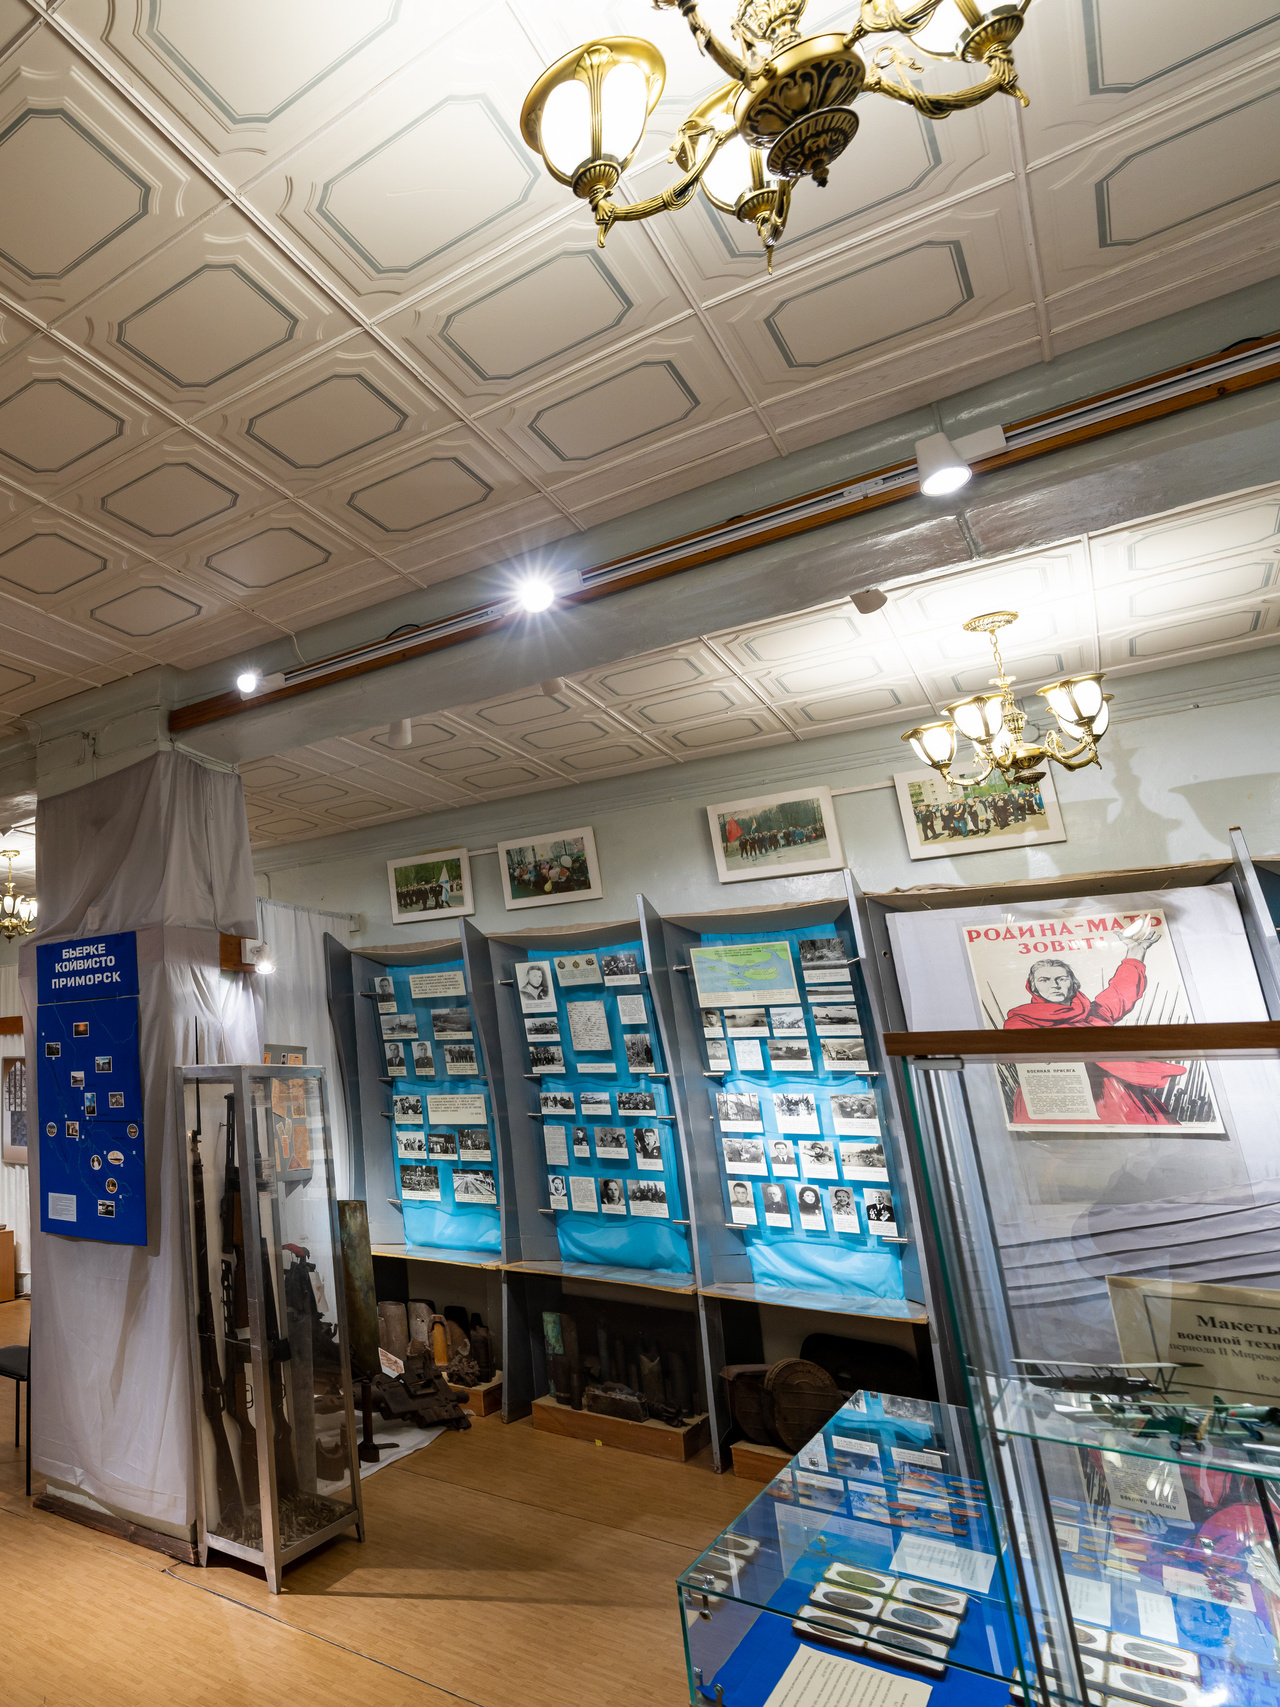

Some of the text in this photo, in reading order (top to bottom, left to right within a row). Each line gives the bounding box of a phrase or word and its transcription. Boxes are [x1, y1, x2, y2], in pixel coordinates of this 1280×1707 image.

[62, 944, 105, 959] БЬЕРКЕ
[55, 956, 115, 973] КОЙВИСТО
[52, 971, 121, 989] ПРИМОРСК
[1177, 1332, 1241, 1346] военной
[1169, 1343, 1280, 1361] периода II Мирово
